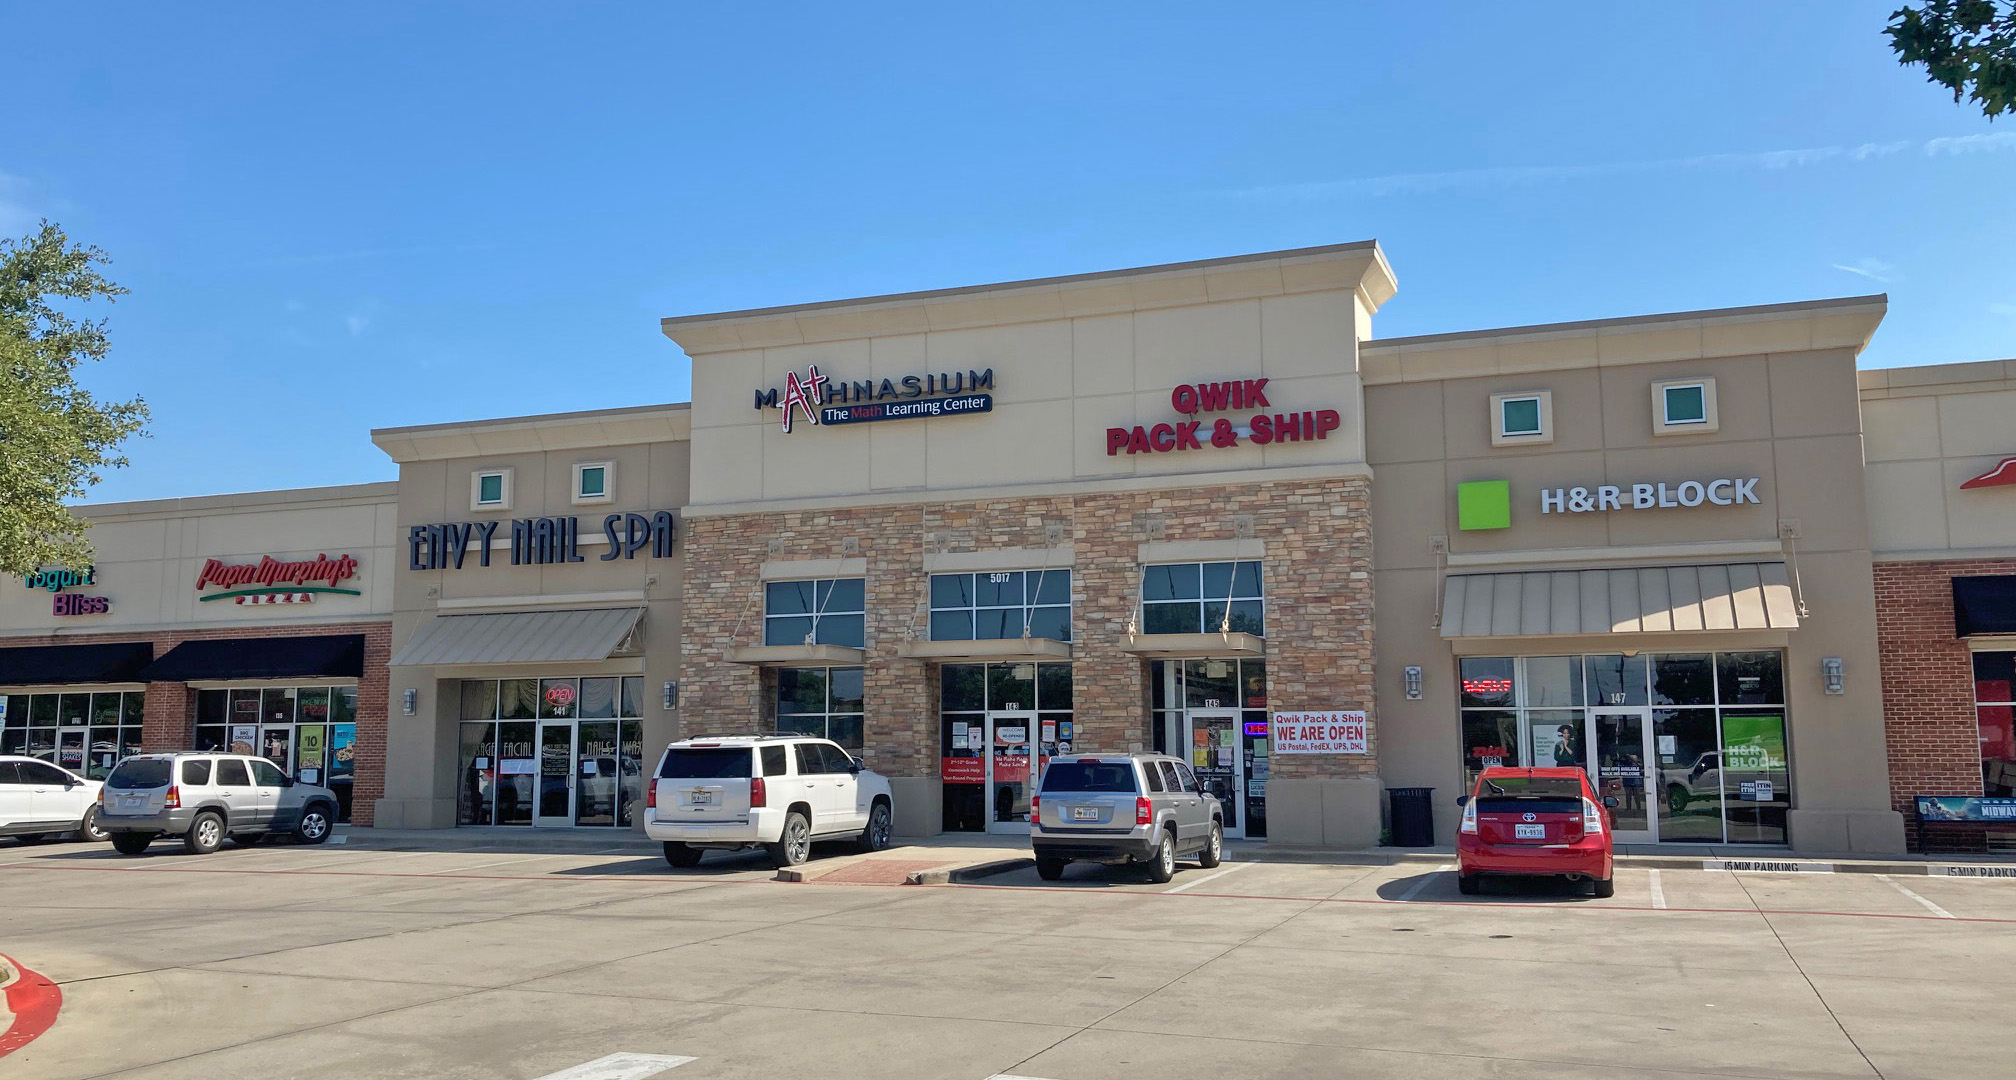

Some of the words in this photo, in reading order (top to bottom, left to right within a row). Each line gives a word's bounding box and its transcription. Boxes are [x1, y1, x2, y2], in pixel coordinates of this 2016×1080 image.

[1171, 378, 1271, 415] QWIK
[825, 408, 849, 421] The
[851, 404, 882, 418] Math
[886, 402, 941, 415] Learning
[943, 396, 986, 411] Center
[1106, 420, 1203, 456] PACK
[1211, 418, 1239, 449] &
[1249, 409, 1341, 445] SHIP
[1541, 485, 1622, 514] H&R
[1632, 477, 1762, 509] BLOCK
[408, 521, 499, 570] ENVY
[511, 516, 585, 566] NAIL
[601, 510, 674, 561] SPA
[196, 558, 257, 590] Papa
[255, 553, 358, 588] Murphy's
[990, 573, 1010, 583] 5017
[24, 565, 96, 592] Yogurt
[53, 594, 109, 616] Bliss
[235, 592, 312, 605] PIZZA
[547, 689, 573, 700] OPEN
[1611, 693, 1626, 704] 147
[553, 707, 565, 715] 141
[1006, 702, 1019, 710] 143
[1276, 714, 1300, 723] Qwik
[1303, 714, 1328, 723] Pack
[1331, 713, 1338, 722] &
[1342, 713, 1363, 724] Ship
[1277, 726, 1296, 740] WE
[1300, 726, 1325, 740] ARE
[1329, 726, 1363, 740] OPEN
[504, 742, 532, 756] FACIAL
[586, 741, 610, 756] NAILS
[1288, 743, 1309, 751] Postal,
[1311, 743, 1332, 751] FedEX,
[1334, 743, 1348, 751] UPS,
[1350, 742, 1363, 750] DHL
[1729, 745, 1760, 756] H&R
[1730, 757, 1780, 767] BLOCK
[1982, 806, 2016, 816] MIDWAY
[1754, 862, 1799, 872] PARKING
